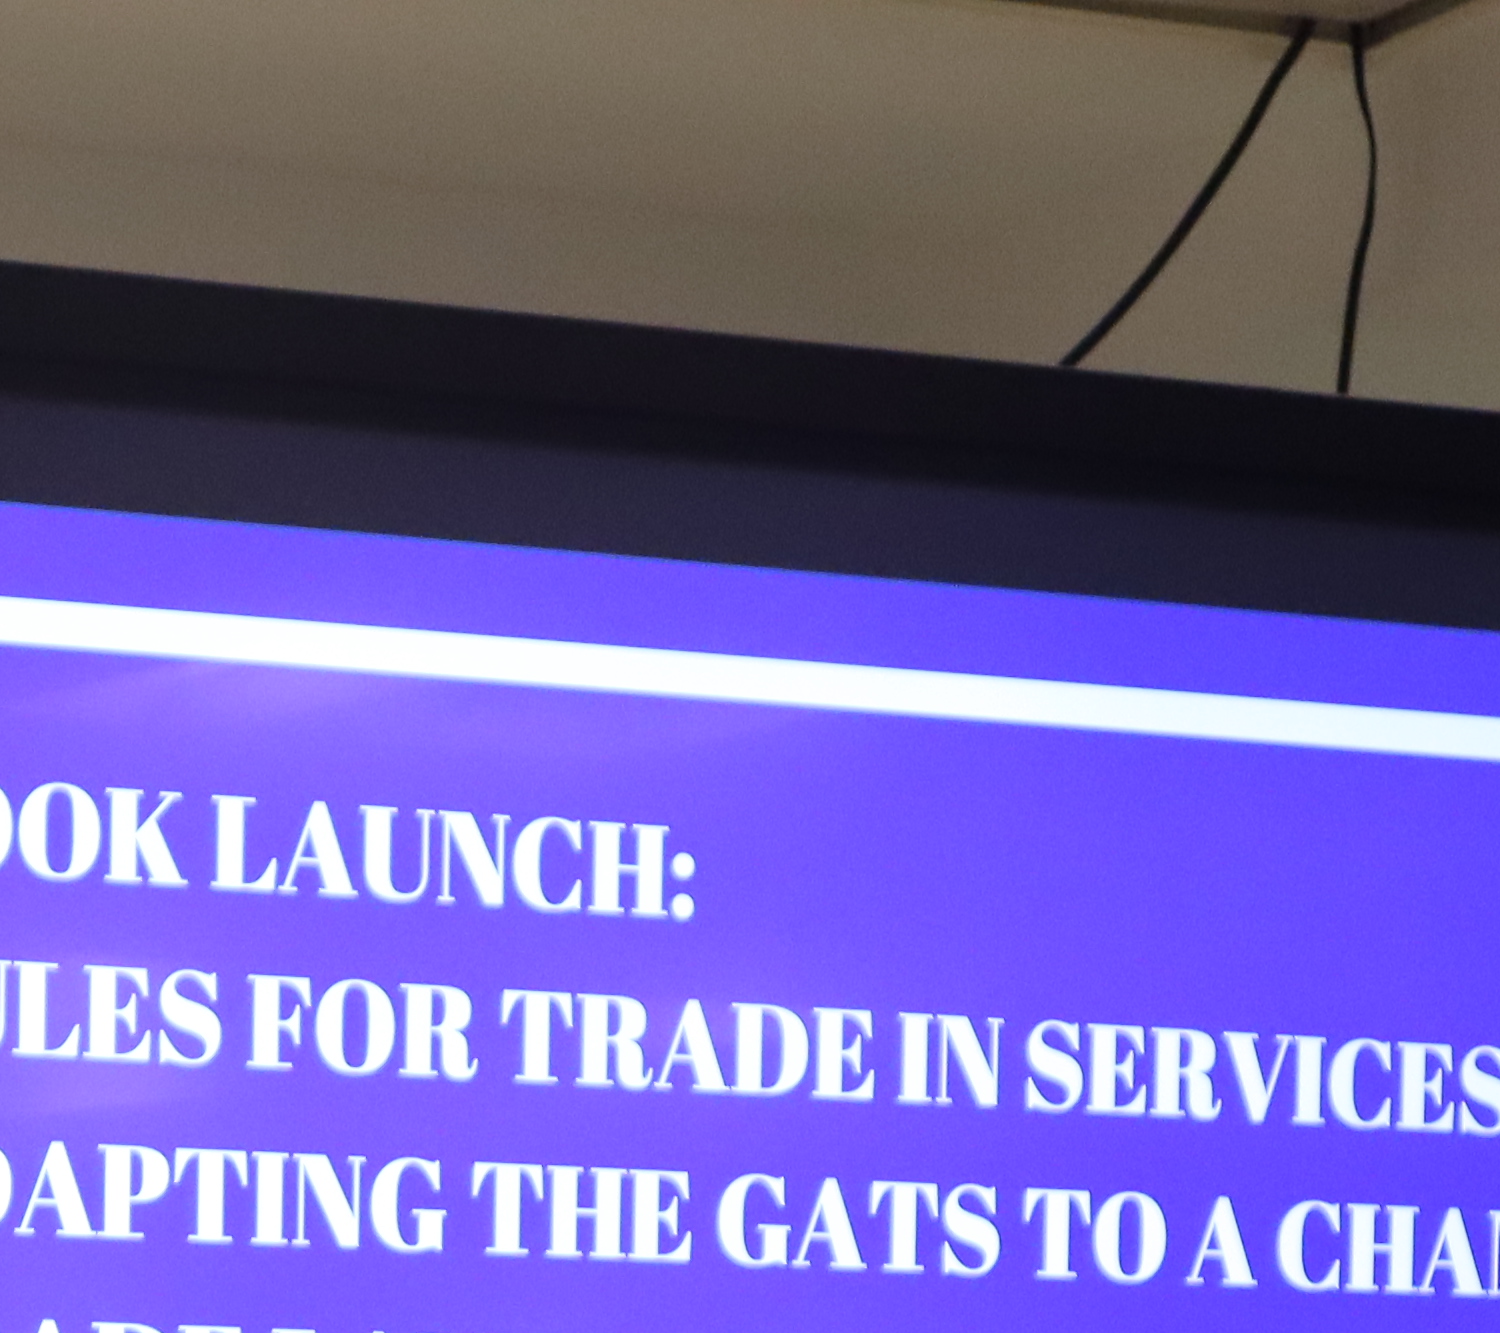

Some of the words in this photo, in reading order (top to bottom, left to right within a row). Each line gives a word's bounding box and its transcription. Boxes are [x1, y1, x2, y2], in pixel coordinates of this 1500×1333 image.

[209, 793, 697, 923] LAUNCH:
[244, 972, 480, 1084] FOR
[499, 987, 876, 1103] TRADE
[895, 1010, 1006, 1110] IN
[470, 1160, 693, 1265] THE
[714, 1171, 1002, 1278] GATS
[1021, 1186, 1168, 1286] TO
[1184, 1194, 1259, 1289] A
